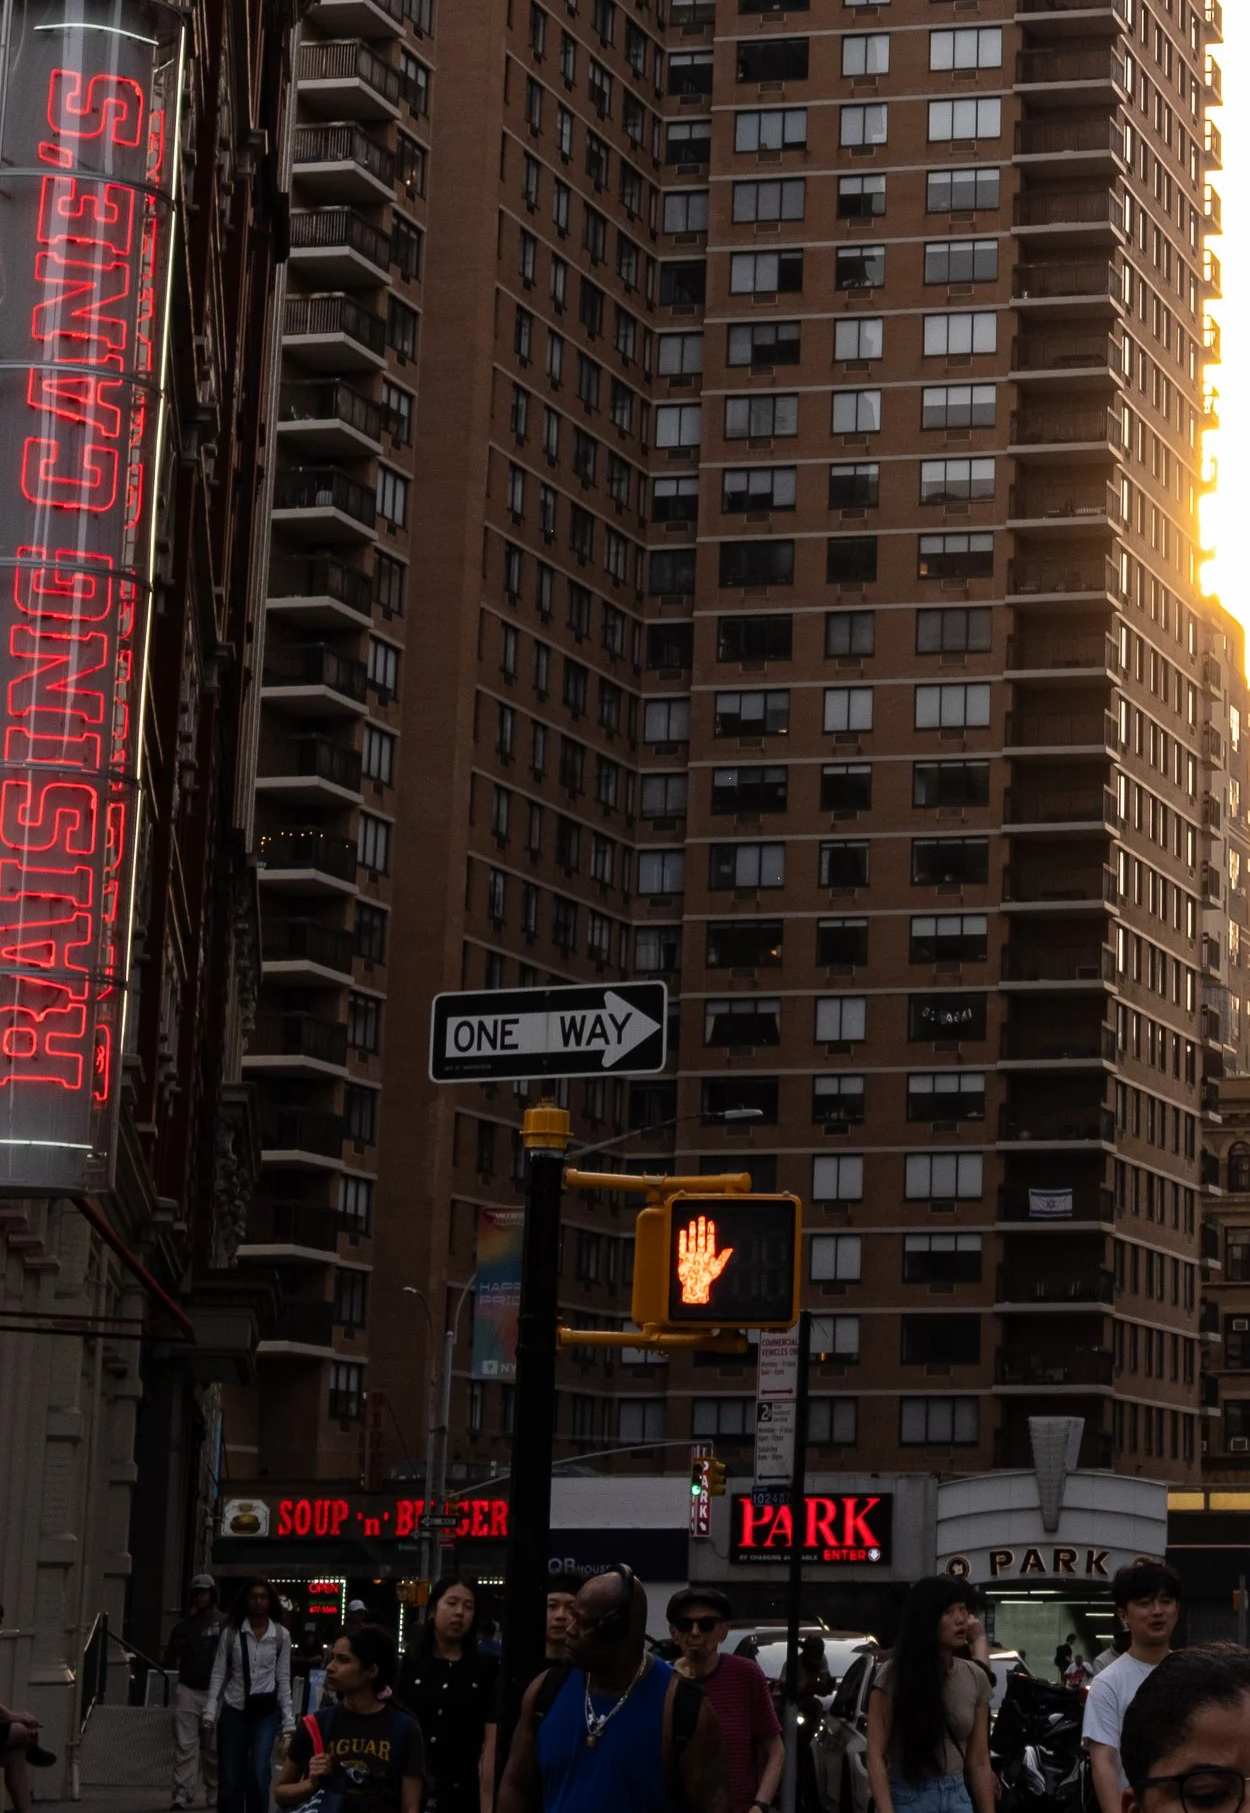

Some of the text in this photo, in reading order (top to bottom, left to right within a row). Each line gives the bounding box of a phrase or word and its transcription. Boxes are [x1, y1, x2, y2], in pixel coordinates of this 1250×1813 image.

[20, 68, 144, 513] CANE'S
[0, 545, 114, 1089] RAISING
[453, 1011, 633, 1053] ONE WAY
[479, 1282, 522, 1292] HAPP
[760, 1404, 769, 1421] 2
[277, 1498, 349, 1538] SOUP
[736, 1495, 882, 1549] PARK
[823, 1549, 866, 1562] ENTER
[989, 1546, 1112, 1576] PARK
[308, 1583, 339, 1595] OPEN
